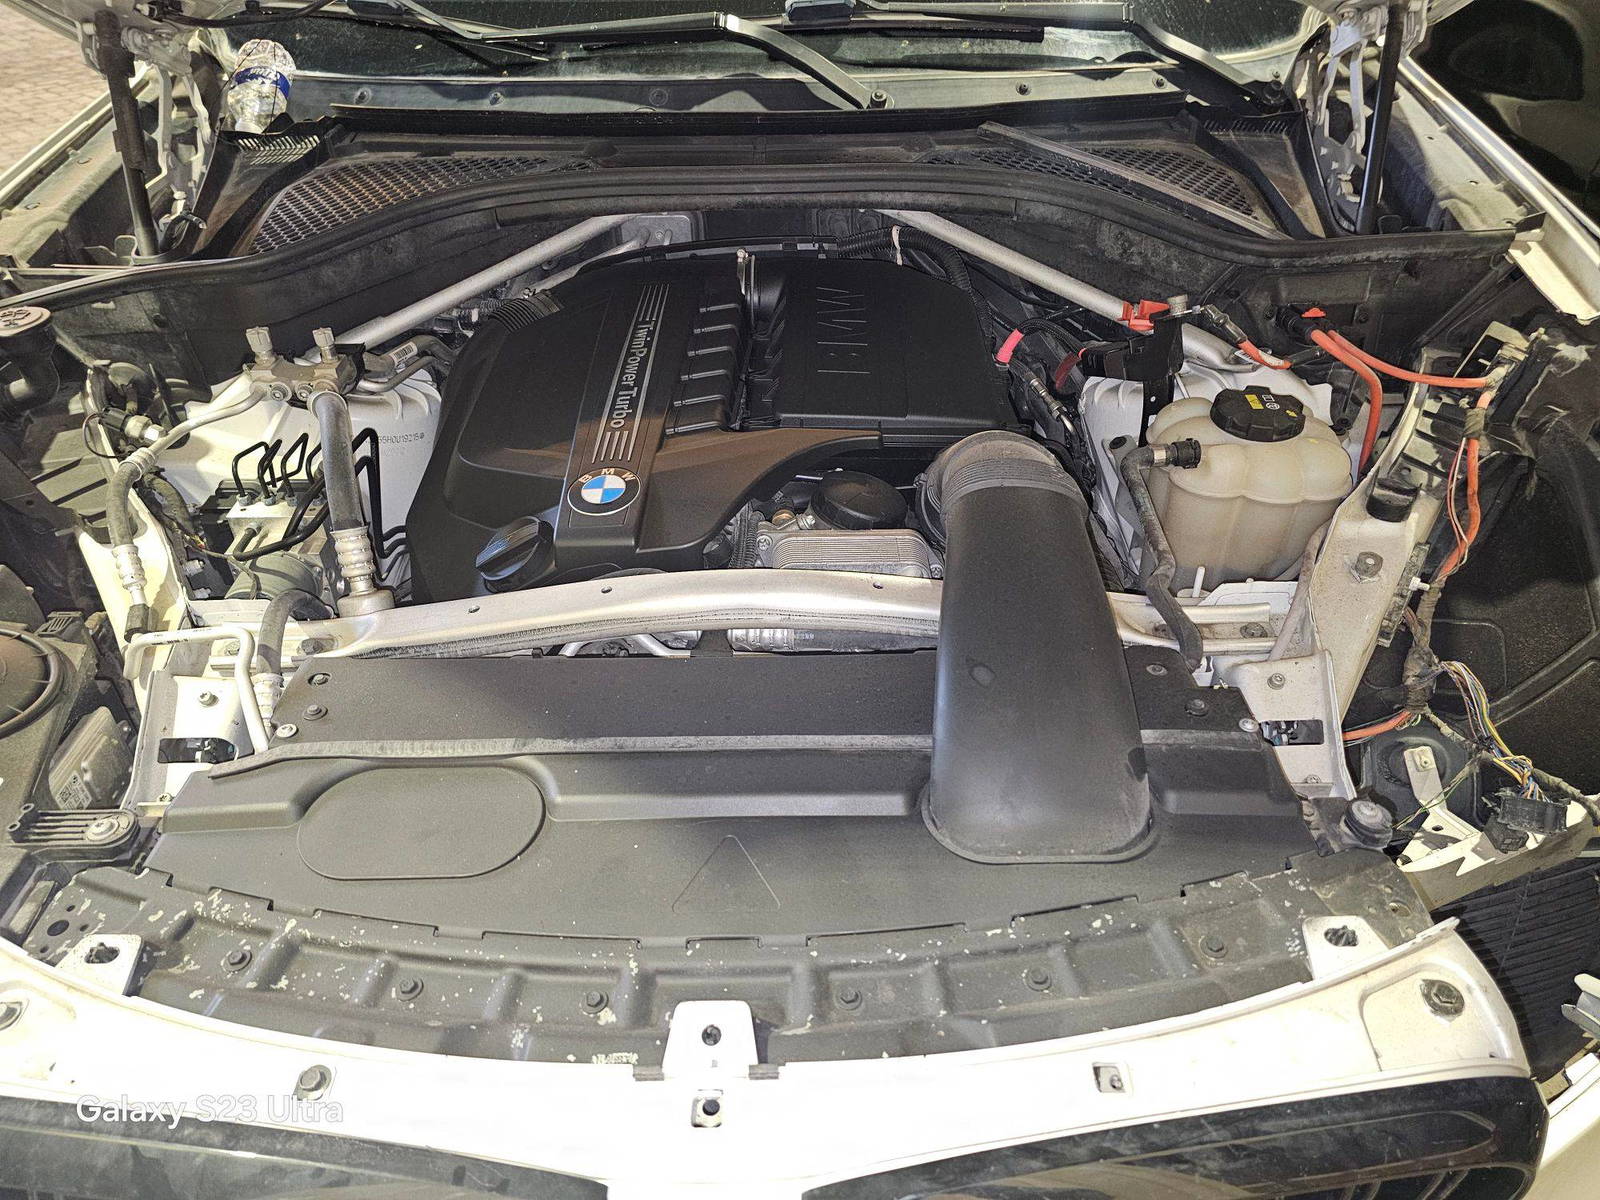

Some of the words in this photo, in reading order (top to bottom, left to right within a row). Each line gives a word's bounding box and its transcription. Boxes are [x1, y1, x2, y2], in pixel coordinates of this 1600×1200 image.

[621, 320, 655, 385] TwinPower
[610, 387, 638, 429] Turbo
[578, 468, 636, 483] BMW
